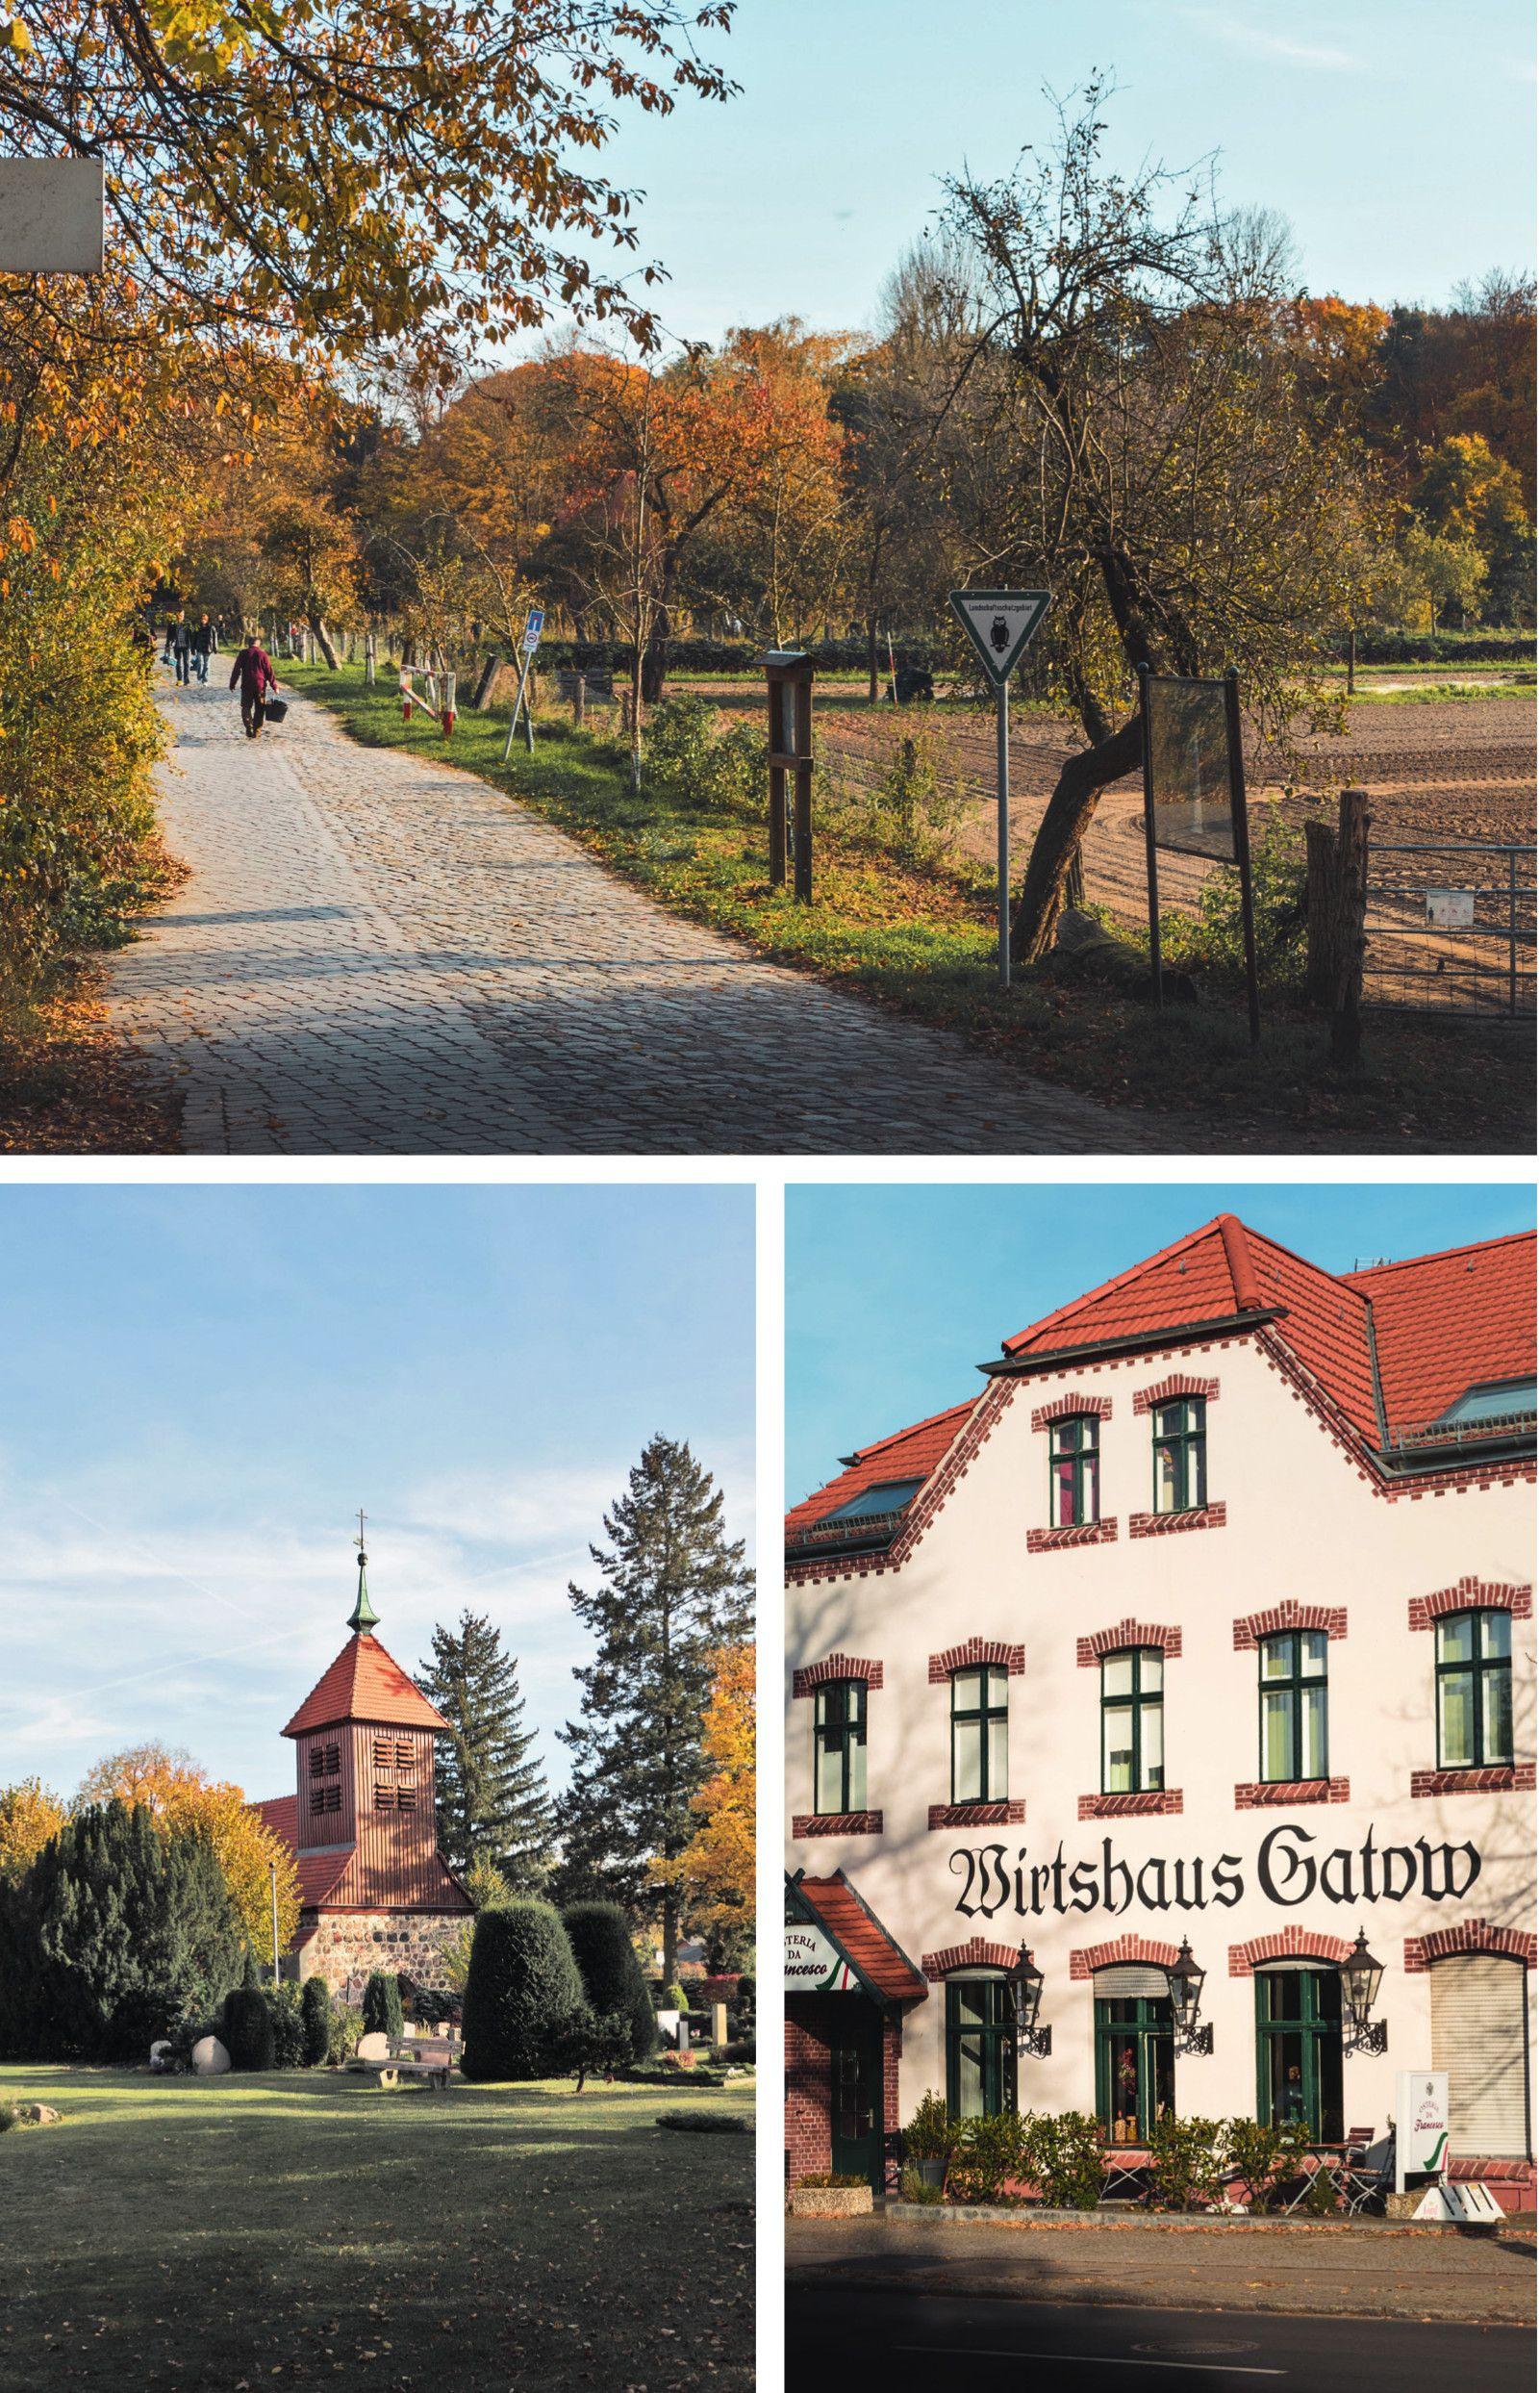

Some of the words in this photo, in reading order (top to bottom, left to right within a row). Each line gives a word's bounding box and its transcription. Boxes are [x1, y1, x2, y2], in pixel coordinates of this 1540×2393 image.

[948, 1836, 1246, 1920] Wirtshaus
[1257, 1822, 1483, 1906] Gatow
[784, 1934, 817, 1952] TERIA
[788, 1949, 801, 1960] DA
[1414, 2119, 1444, 2132] Francesco
